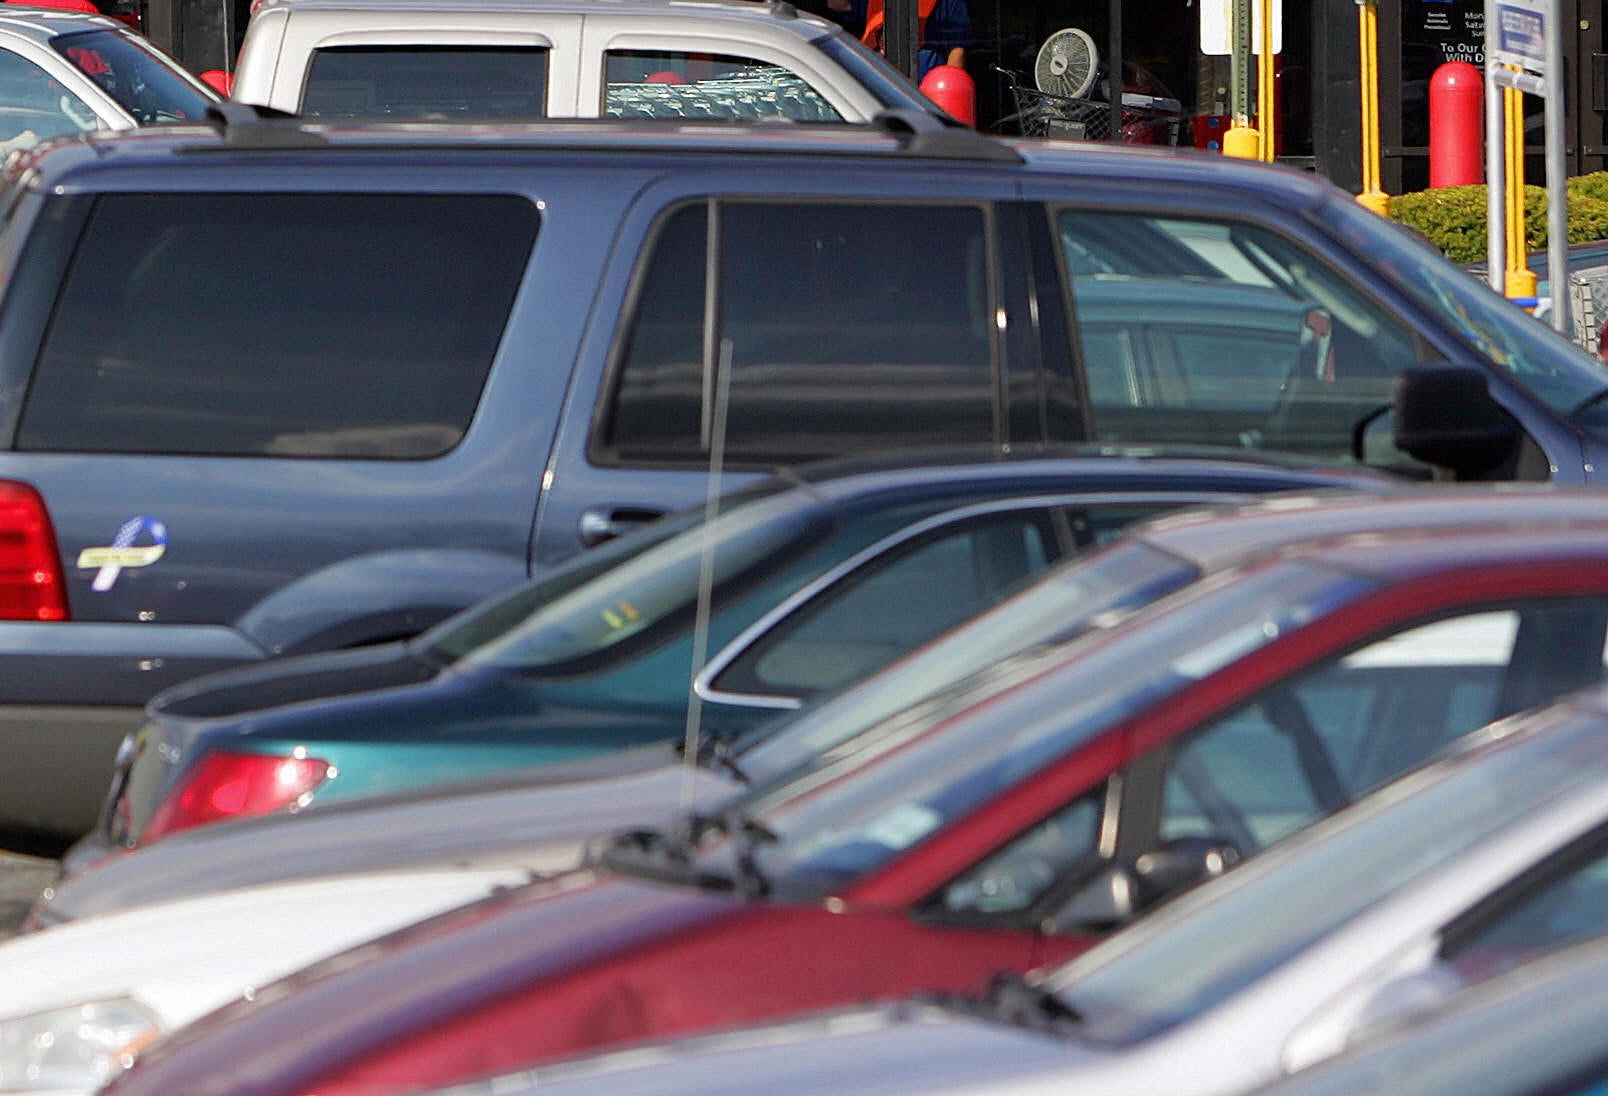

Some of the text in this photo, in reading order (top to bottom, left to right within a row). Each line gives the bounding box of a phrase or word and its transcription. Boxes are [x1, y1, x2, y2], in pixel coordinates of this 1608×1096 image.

[1440, 43, 1454, 52] To
[1457, 43, 1478, 53] Our
[1445, 53, 1472, 62] With
